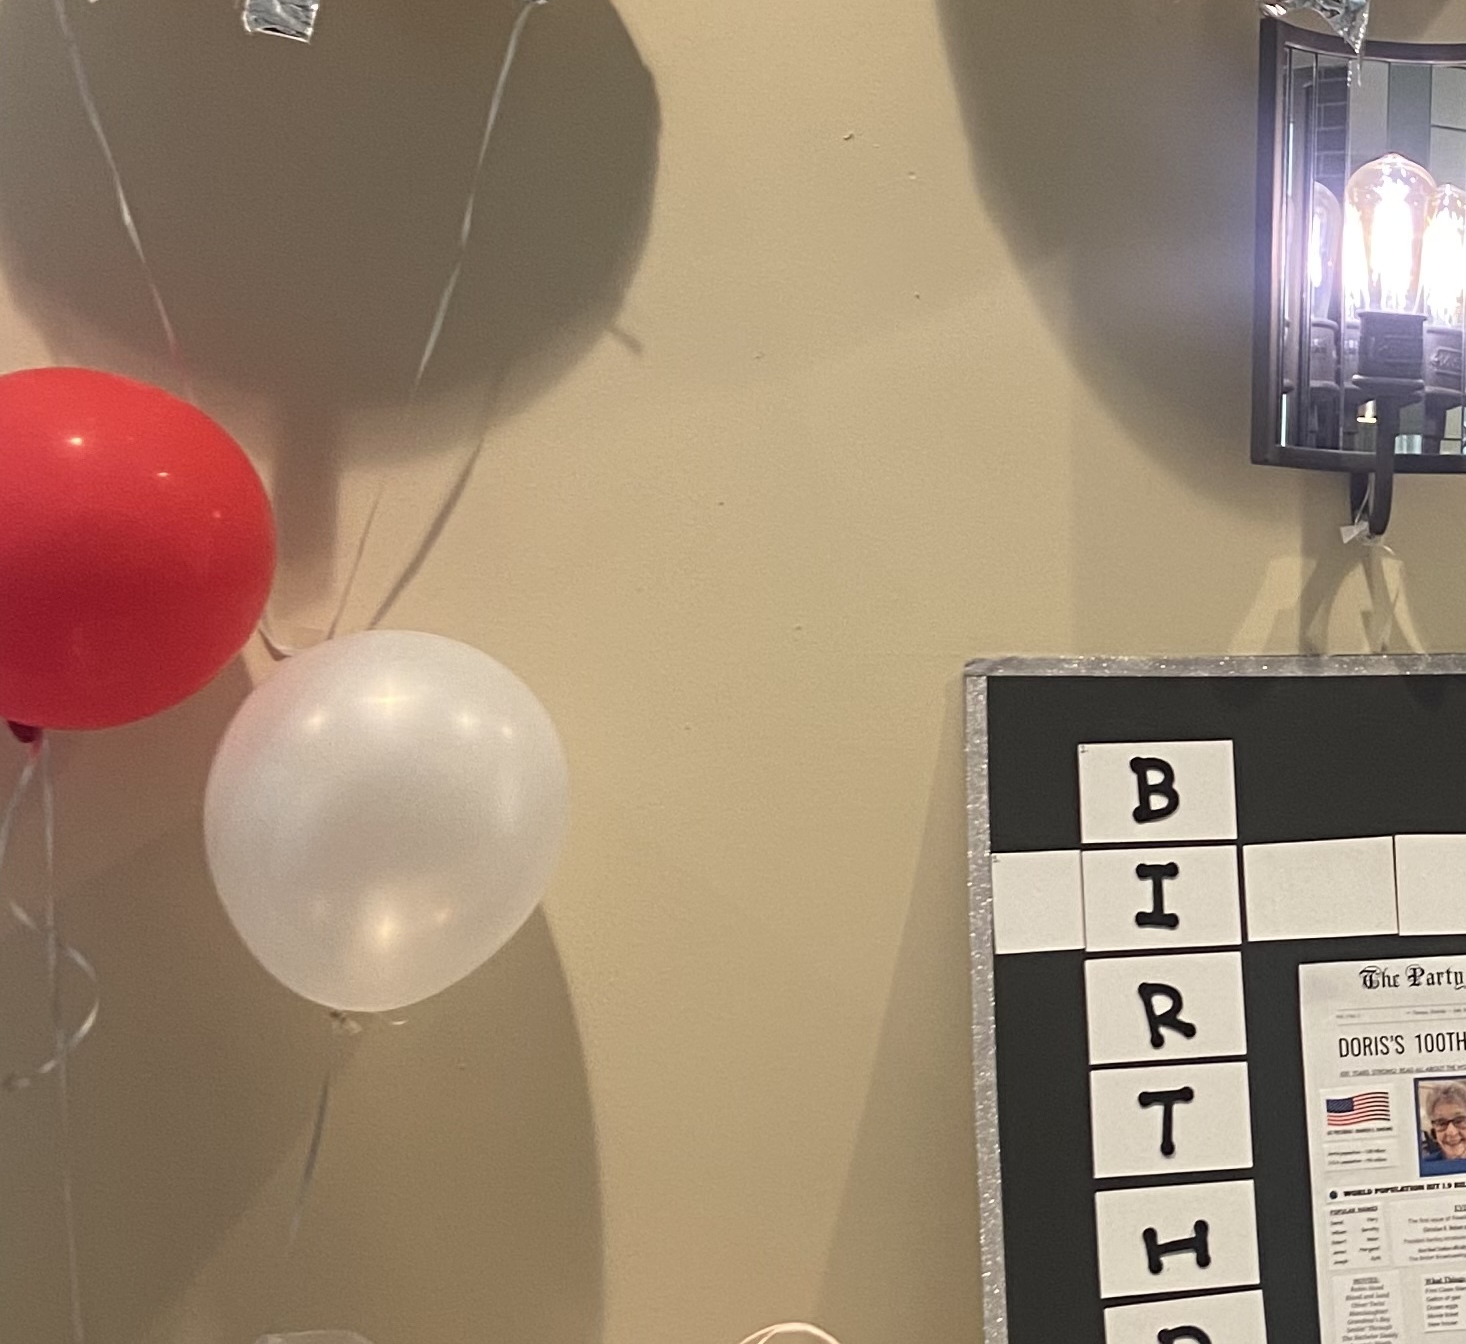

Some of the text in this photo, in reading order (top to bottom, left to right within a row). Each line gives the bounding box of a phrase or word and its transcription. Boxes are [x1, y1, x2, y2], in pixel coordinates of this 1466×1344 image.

[1359, 965, 1399, 989] The
[1405, 964, 1466, 990] Party
[1338, 1035, 1405, 1058] DORIS'S
[1414, 1031, 1466, 1054] 100TH
[1374, 1184, 1425, 1194] POPULATION
